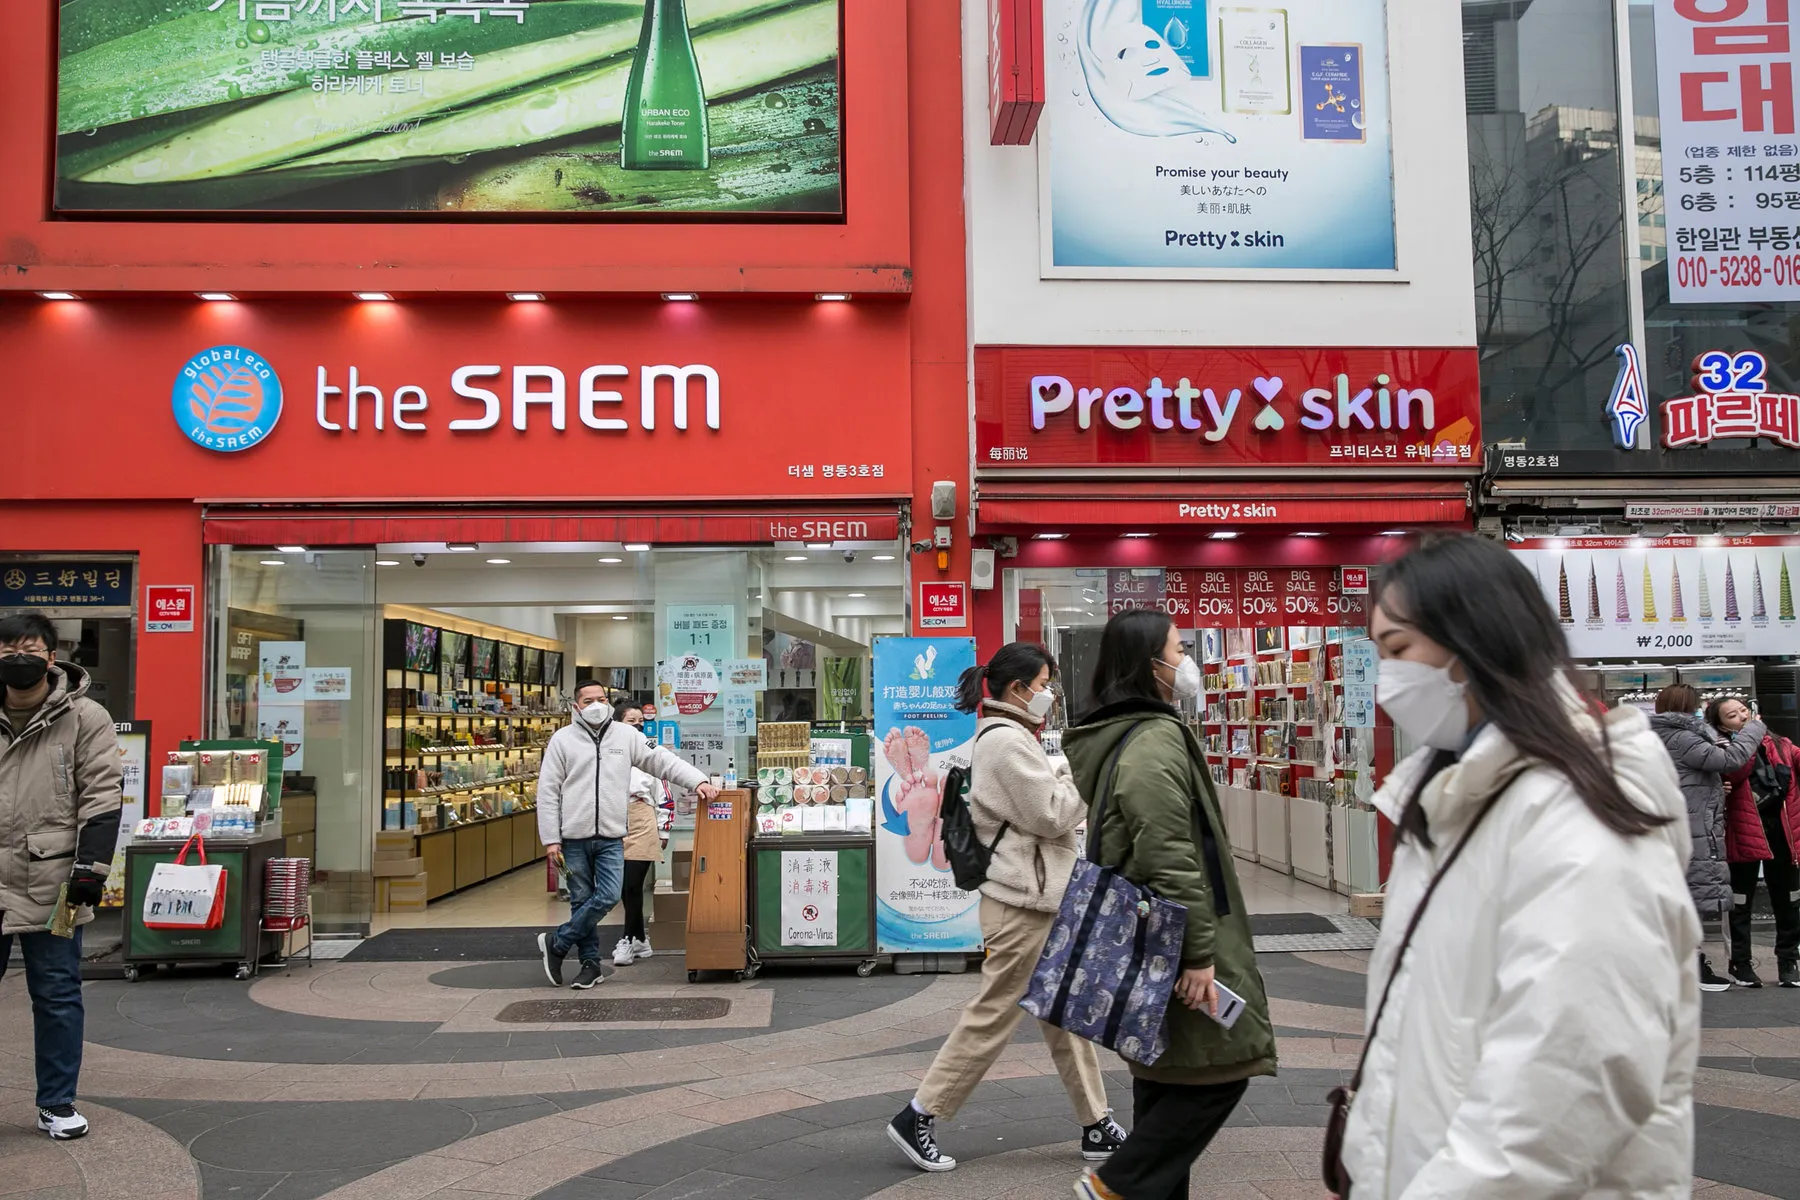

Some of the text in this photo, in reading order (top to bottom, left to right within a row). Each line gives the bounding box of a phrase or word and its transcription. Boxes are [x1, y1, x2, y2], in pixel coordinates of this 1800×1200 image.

[261, 50, 475, 70] 탱글탱글한 플랙스 젤 보습
[312, 75, 424, 95] 하라케케 토너
[1685, 144, 1798, 158] (업종 제한 없음)
[1155, 165, 1289, 182] Promise your beauty
[1679, 164, 1716, 184] 5층
[1180, 184, 1267, 196] 美しいあなたへの
[1680, 192, 1717, 212] 6층
[1165, 230, 1284, 250] Pretty skin
[1676, 227, 1741, 252] 한일관
[184, 348, 270, 379] global eco
[1700, 352, 1766, 392] 32
[316, 364, 720, 432] the SAEM
[1030, 373, 1435, 442] Pretty skin
[1667, 393, 1800, 447] 파르페
[191, 426, 263, 448] the SAEM
[989, 447, 1028, 460] 每丽说
[1330, 445, 1472, 458] 프리티스킨 유네스코점
[1504, 455, 1559, 468] 명동2호점
[788, 464, 884, 477] 더샘 명동3호점
[1179, 503, 1277, 520] Pretty skin
[1630, 507, 1650, 515] 최초로
[1739, 507, 1758, 515] 판매한
[770, 521, 868, 538] the SAEM
[1205, 572, 1225, 582] BIG
[1248, 571, 1268, 581] BIG
[1291, 570, 1310, 581] BIG
[1114, 583, 1145, 593] SALE
[1158, 583, 1188, 593] SALE
[1200, 583, 1231, 594] SALE
[1243, 582, 1274, 593] SALE
[1286, 582, 1316, 592] SALE
[155, 598, 185, 610] 에스원
[929, 595, 957, 606] 에스원
[1156, 598, 1190, 615] 50%
[1199, 598, 1233, 615] 50%
[1243, 597, 1277, 614] 50%
[1285, 596, 1319, 613] 50%
[1327, 596, 1361, 613] 50%
[711, 620, 727, 629] 증정
[690, 633, 710, 645] 1:1
[1655, 635, 1692, 649] 2,000
[708, 740, 723, 750] 증정
[691, 753, 711, 766] 1:1
[788, 857, 832, 874] 消毒液
[788, 927, 834, 940] Corona-Virus
[923, 931, 949, 939] SAEM
